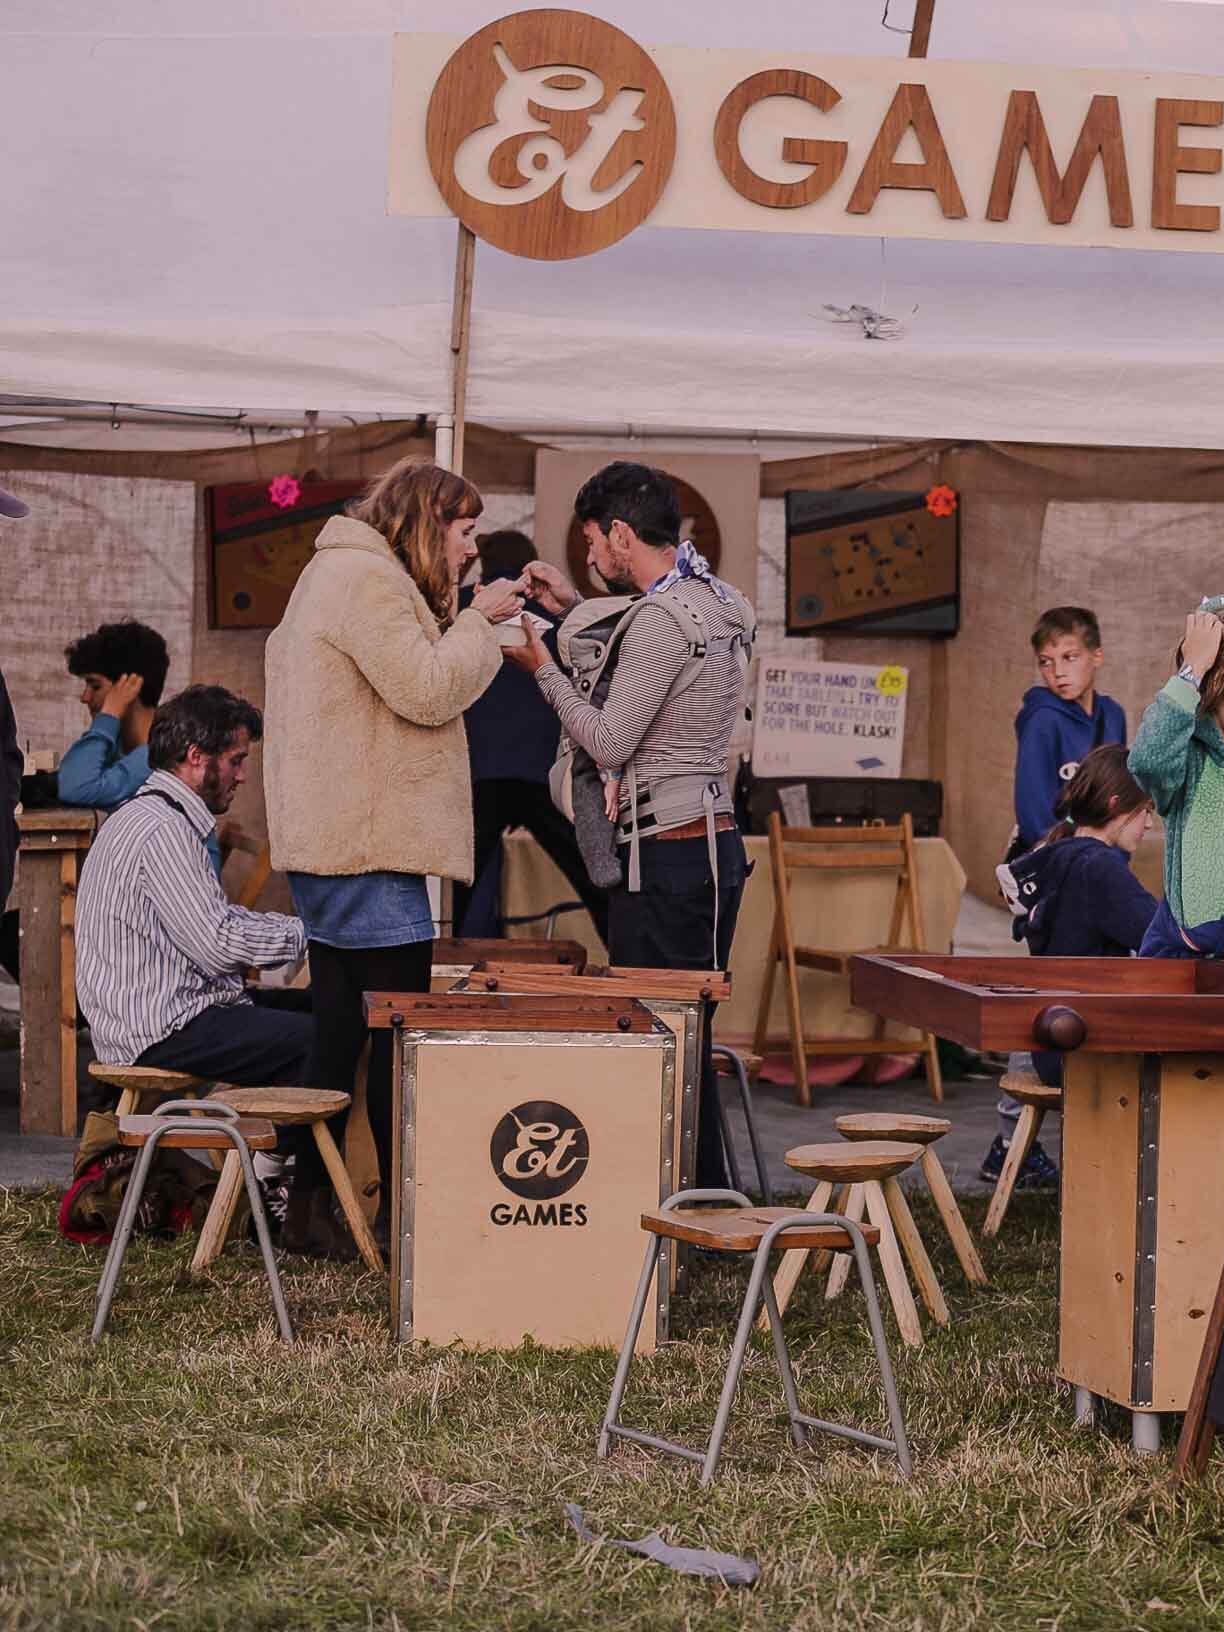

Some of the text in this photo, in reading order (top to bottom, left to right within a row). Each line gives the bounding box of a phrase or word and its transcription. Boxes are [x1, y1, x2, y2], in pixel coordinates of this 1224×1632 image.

[765, 669, 786, 683] GET
[824, 674, 857, 688] HAND
[859, 691, 880, 705] TRY
[763, 701, 801, 715] SCORE
[805, 703, 828, 718] BUT
[762, 716, 786, 731] FOR
[789, 718, 810, 733] THE
[853, 722, 897, 739] KLASK!
[489, 1203, 588, 1227] GAMES
